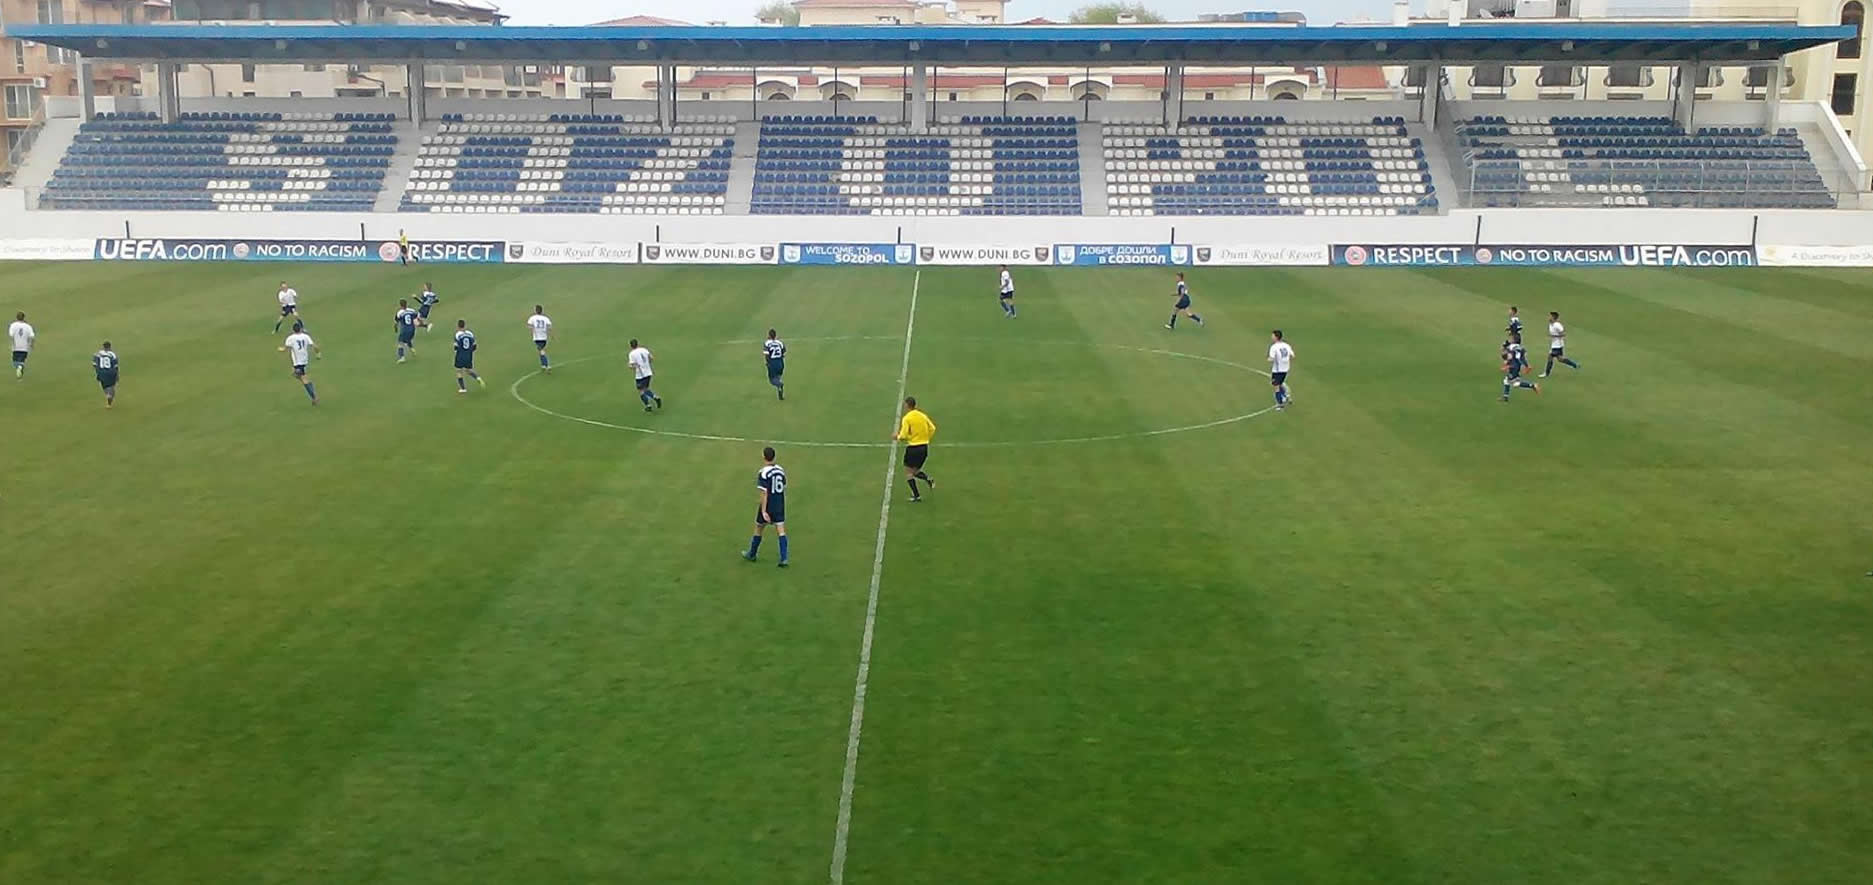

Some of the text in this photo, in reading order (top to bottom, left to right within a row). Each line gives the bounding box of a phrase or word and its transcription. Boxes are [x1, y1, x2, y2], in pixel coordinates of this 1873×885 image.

[99, 239, 227, 261] UEFA.com
[256, 244, 367, 258] NO TO RACISM
[408, 243, 494, 260] RESPECT
[530, 245, 633, 260] Duni Royal Resort
[664, 247, 756, 260] WWW.DUNI.BG
[804, 245, 871, 255] WELCOME TO
[938, 248, 1031, 261] WWW.DUNI.BG
[1079, 245, 1157, 256] ДОБРЕ ДОШЛИ
[1221, 248, 1323, 262] Duni Royal Resort
[1373, 246, 1462, 264] RESPECT
[1500, 249, 1613, 263] NO TO RACISM
[1619, 245, 1752, 266] UEFA.com
[834, 253, 889, 264] SOZOPOL
[1108, 254, 1166, 264] СОЗОПОЛ
[404, 313, 412, 325] 6
[462, 337, 470, 350] 9
[770, 346, 782, 359] 23
[98, 356, 112, 369] 18
[771, 475, 785, 494] 16
